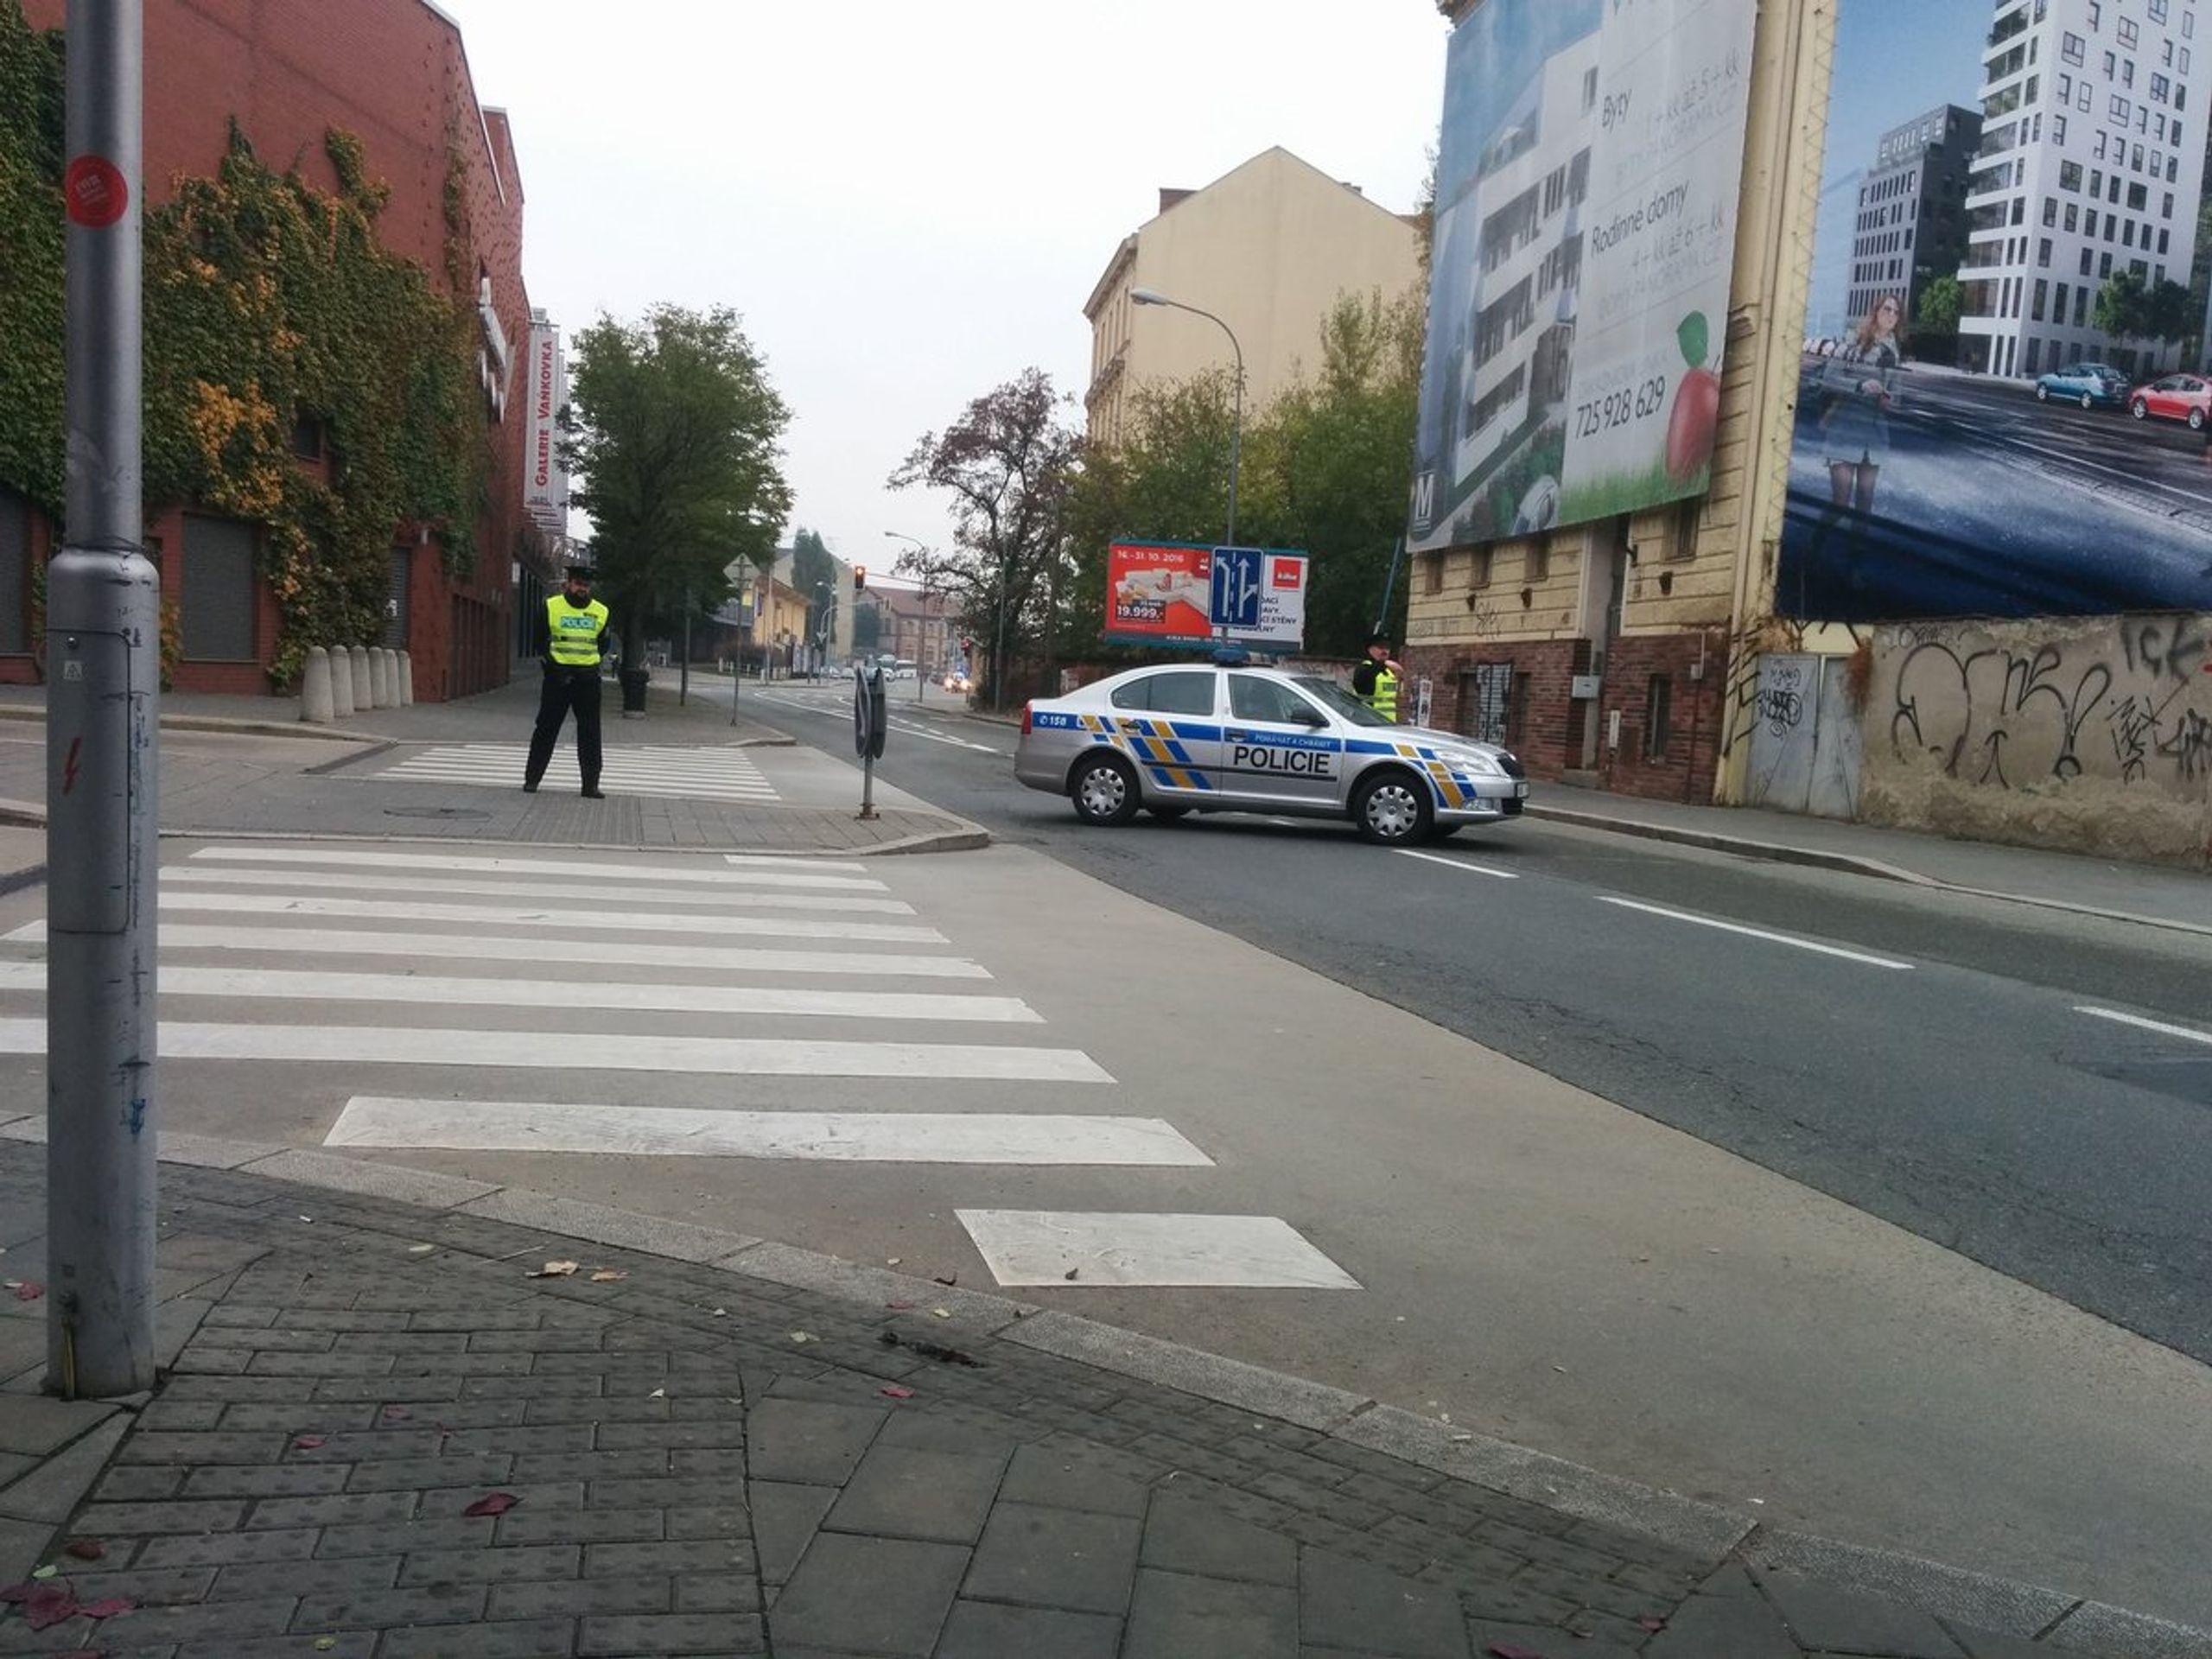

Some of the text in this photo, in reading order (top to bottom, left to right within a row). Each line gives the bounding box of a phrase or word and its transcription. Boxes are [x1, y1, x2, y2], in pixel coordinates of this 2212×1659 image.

[1602, 89, 1632, 133] Byty
[1592, 198, 1644, 259] Rodinné
[1646, 179, 1690, 225] domy
[1576, 399, 1601, 439] 725
[1604, 388, 1631, 429] 928
[1635, 375, 1666, 419] 629
[1050, 715, 1067, 727] 158
[1233, 745, 1331, 774] POLICIE
